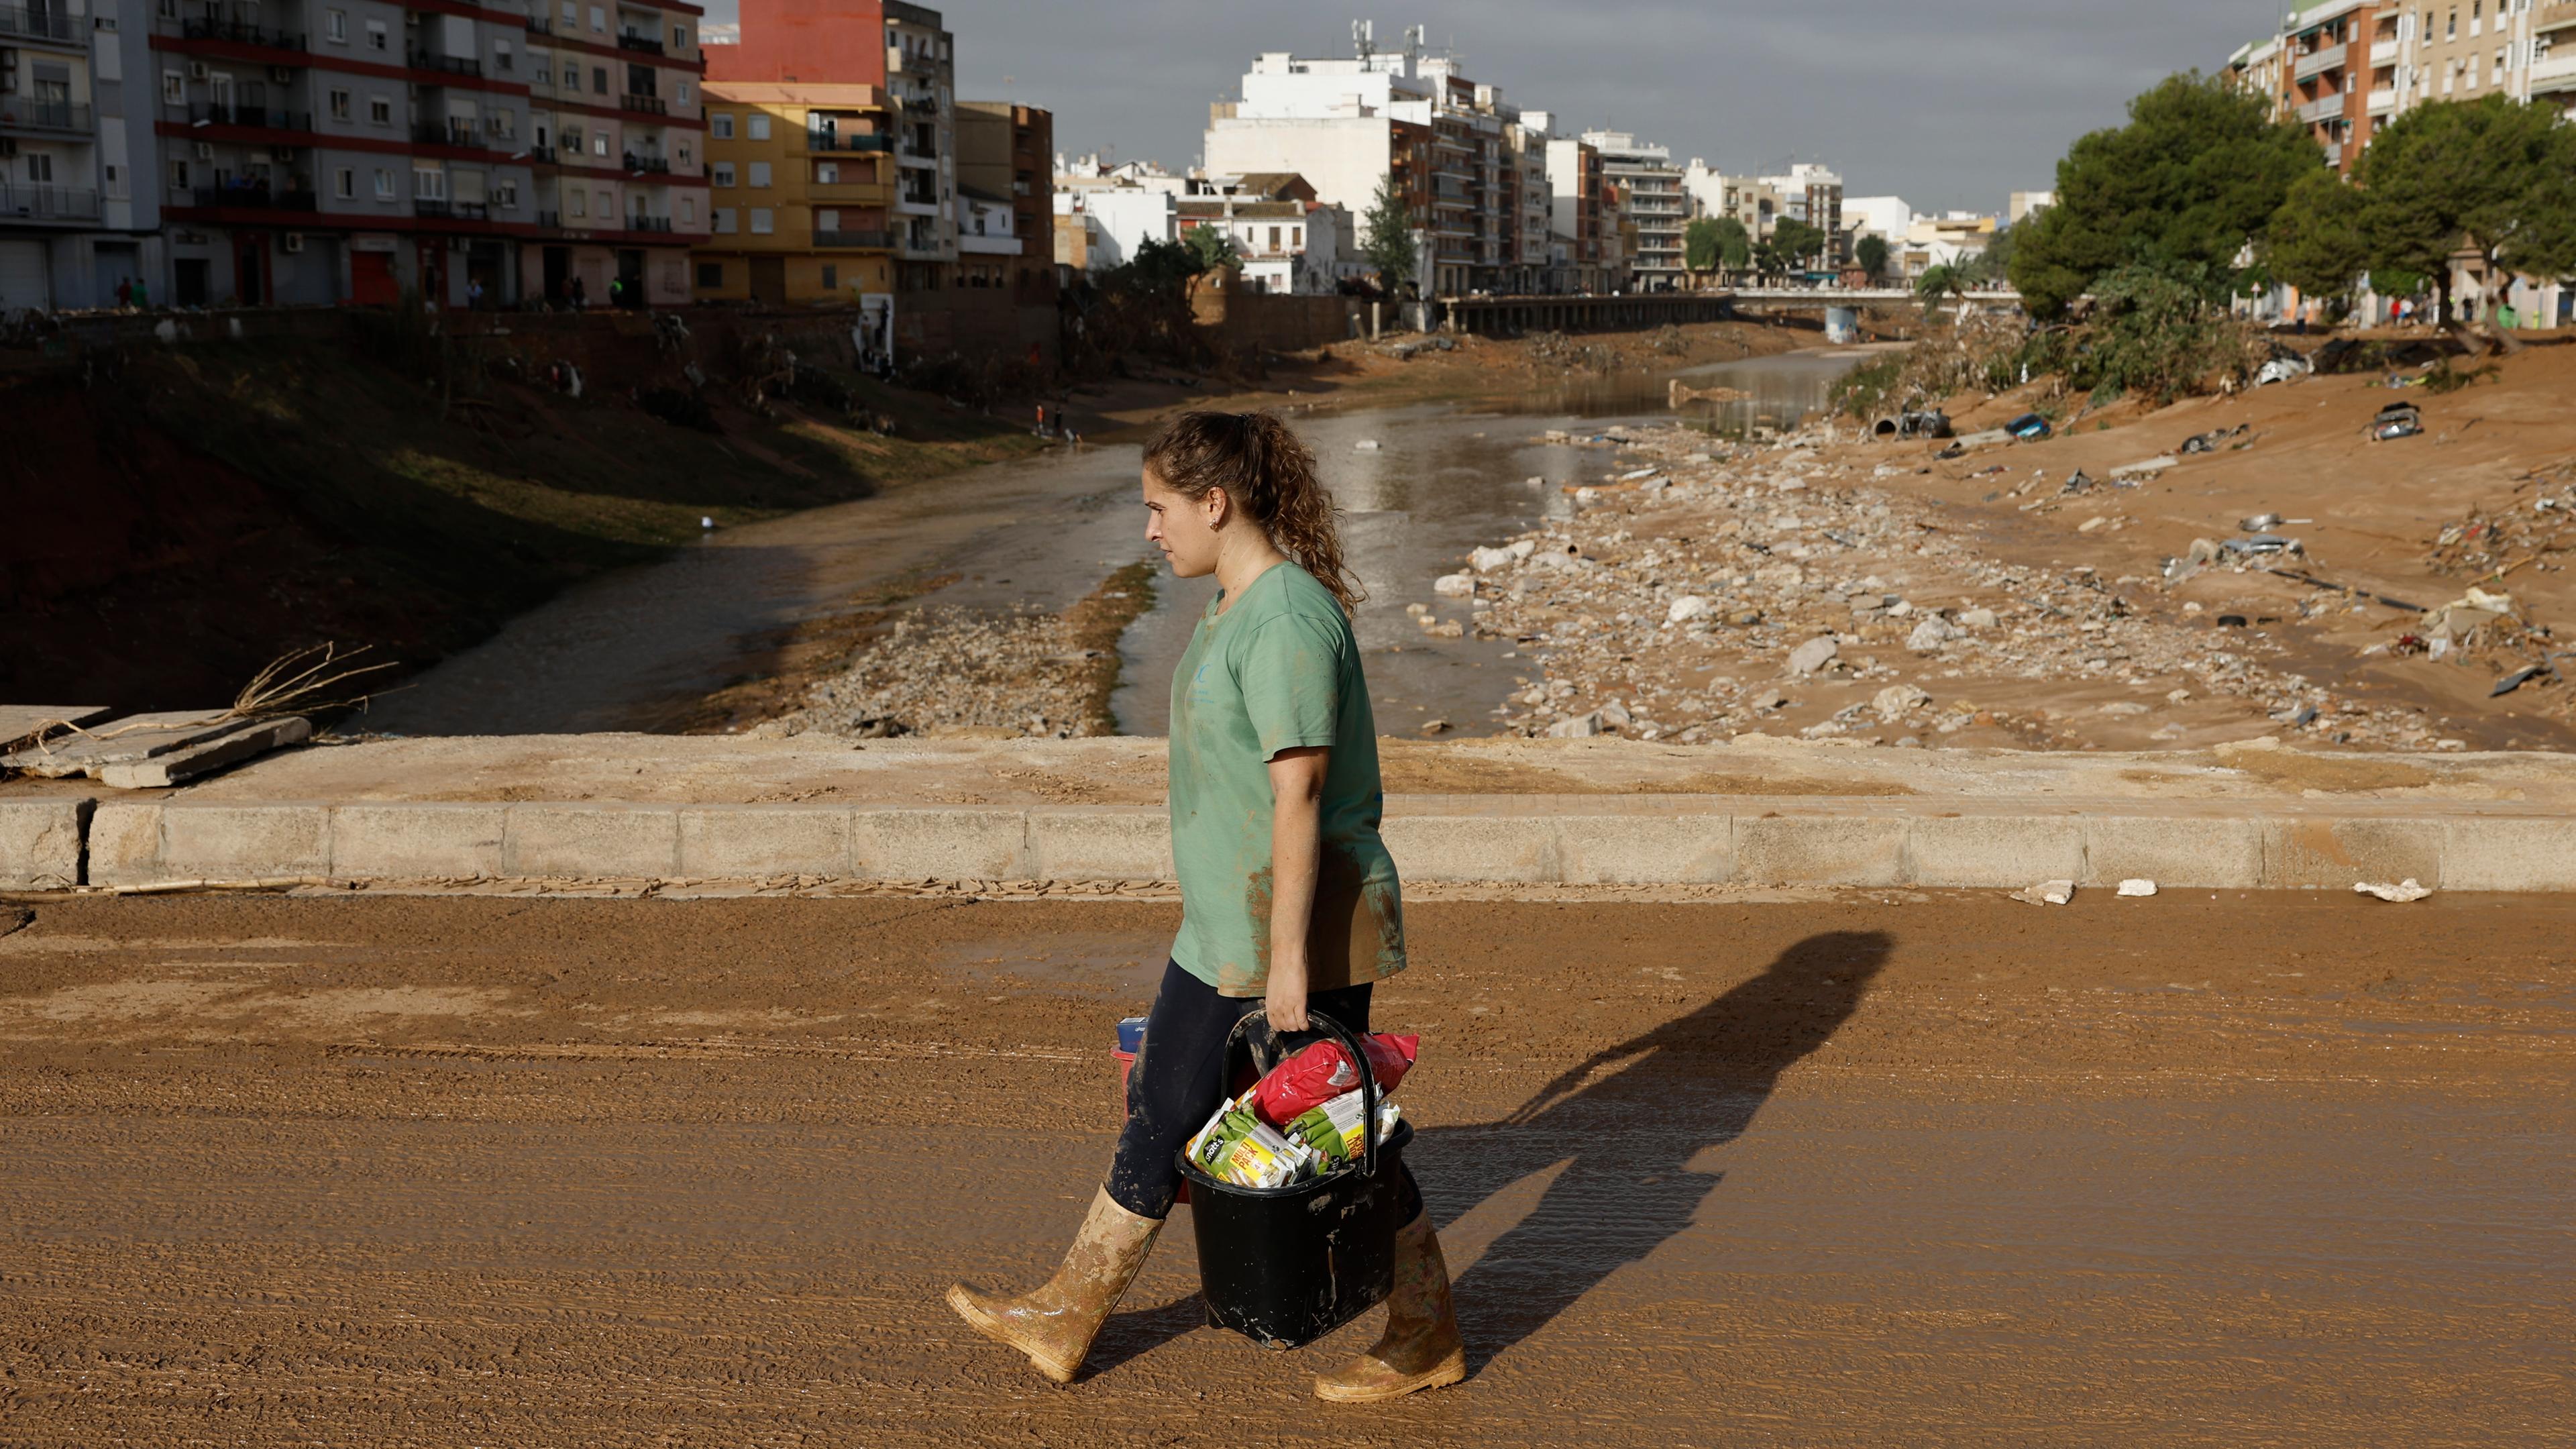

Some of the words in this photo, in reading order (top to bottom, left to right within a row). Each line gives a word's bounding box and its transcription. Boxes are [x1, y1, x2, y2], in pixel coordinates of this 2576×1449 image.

[1205, 1137, 1224, 1162] snatt's
[1232, 1141, 1250, 1164] MULTI
[1346, 1138, 1358, 1159] MULTI
[1352, 1133, 1364, 1158] PACK
[1238, 1146, 1258, 1170] PACK
